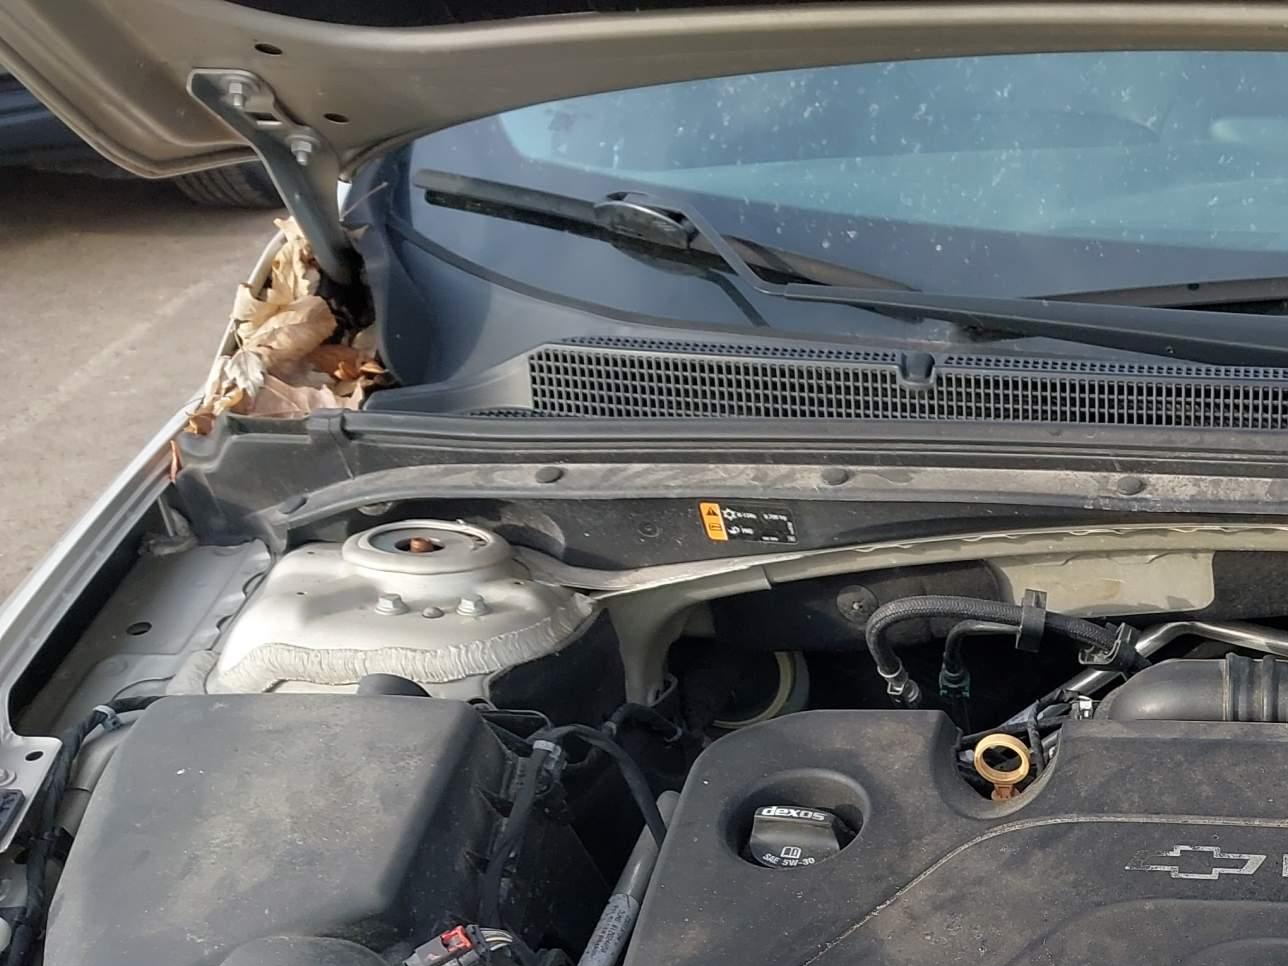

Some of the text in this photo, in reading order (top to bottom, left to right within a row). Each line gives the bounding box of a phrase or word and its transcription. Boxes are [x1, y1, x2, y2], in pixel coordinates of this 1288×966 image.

[762, 806, 825, 821] dexos
[762, 853, 816, 867] SAE 5W-30
